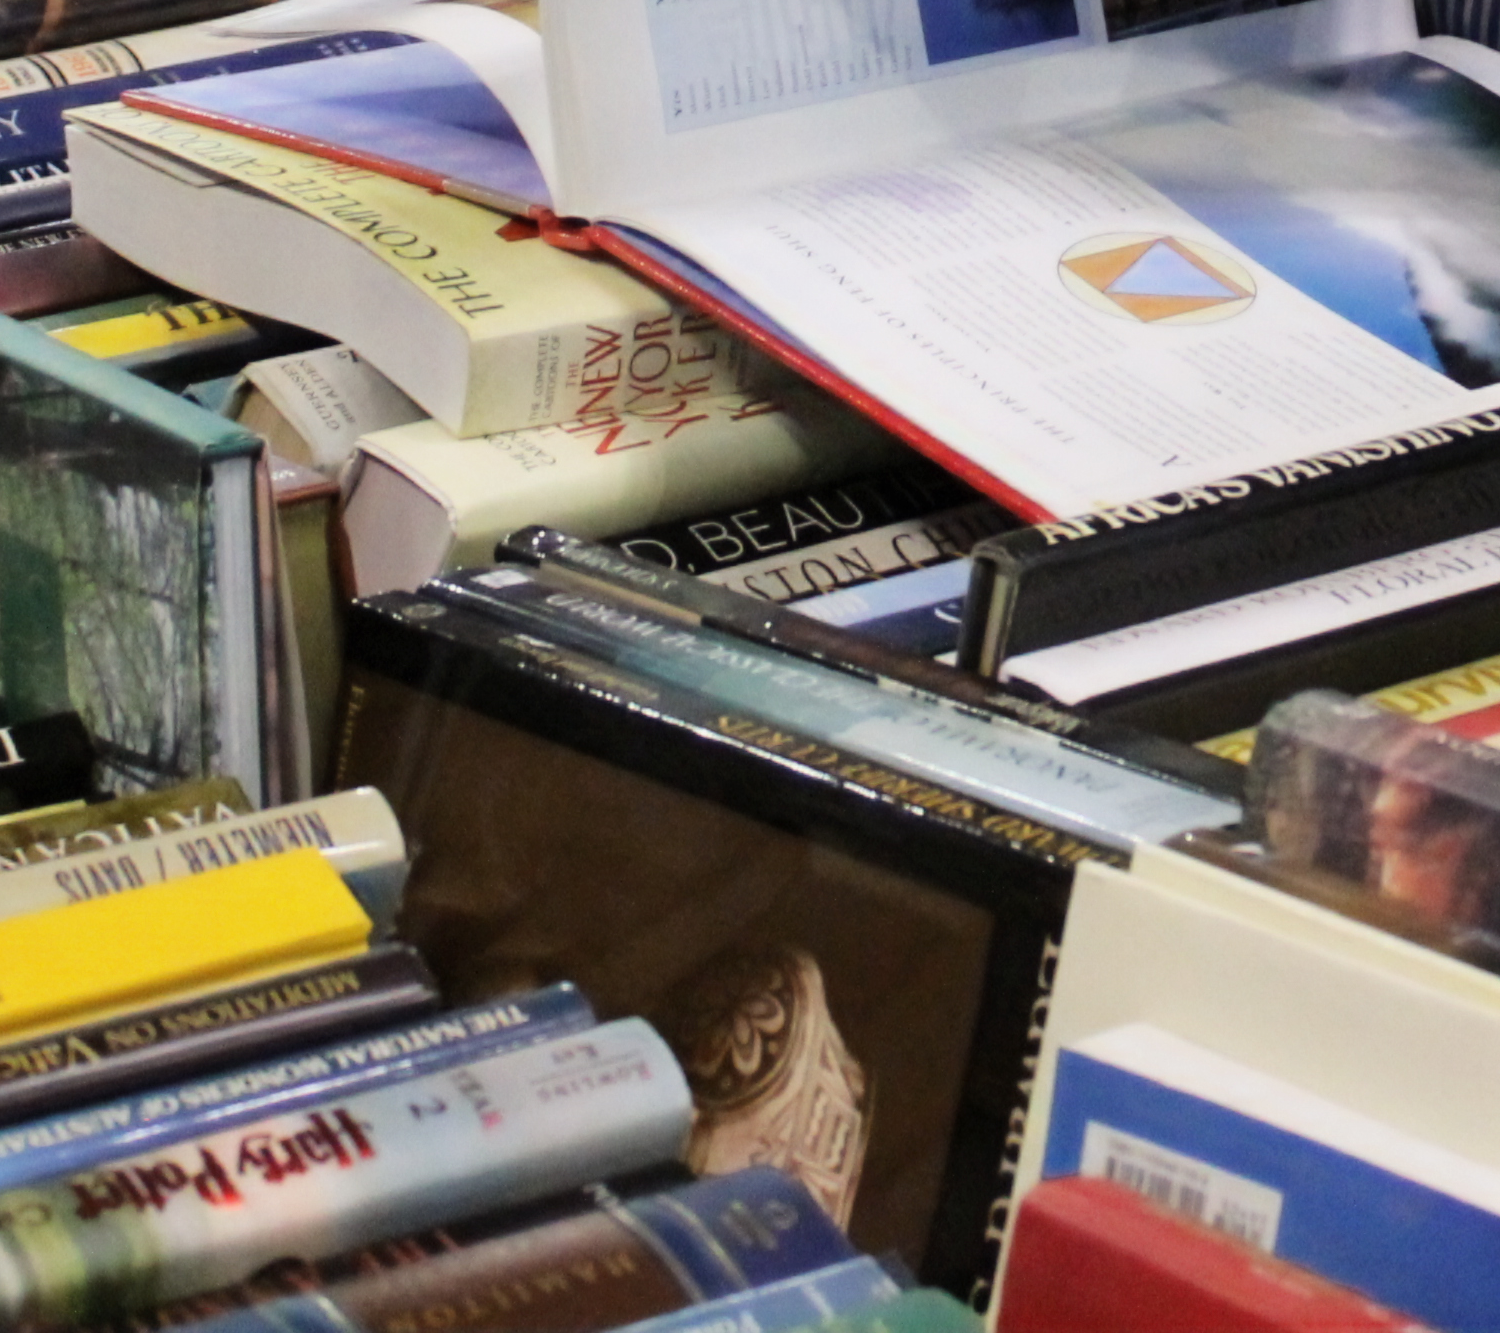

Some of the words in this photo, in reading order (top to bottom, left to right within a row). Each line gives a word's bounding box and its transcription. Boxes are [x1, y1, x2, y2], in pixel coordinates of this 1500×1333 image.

[300, 188, 437, 262] COMPLETE
[424, 266, 505, 319] THE
[276, 360, 342, 433] GUERNSEY
[565, 359, 581, 391] THE
[578, 324, 623, 412] NEW
[1329, 557, 1488, 607] FLORAL
[54, 855, 144, 905] DAVIS
[485, 1001, 531, 1033] THE
[238, 1105, 380, 1185] Harry
[71, 1144, 245, 1221] Potter
